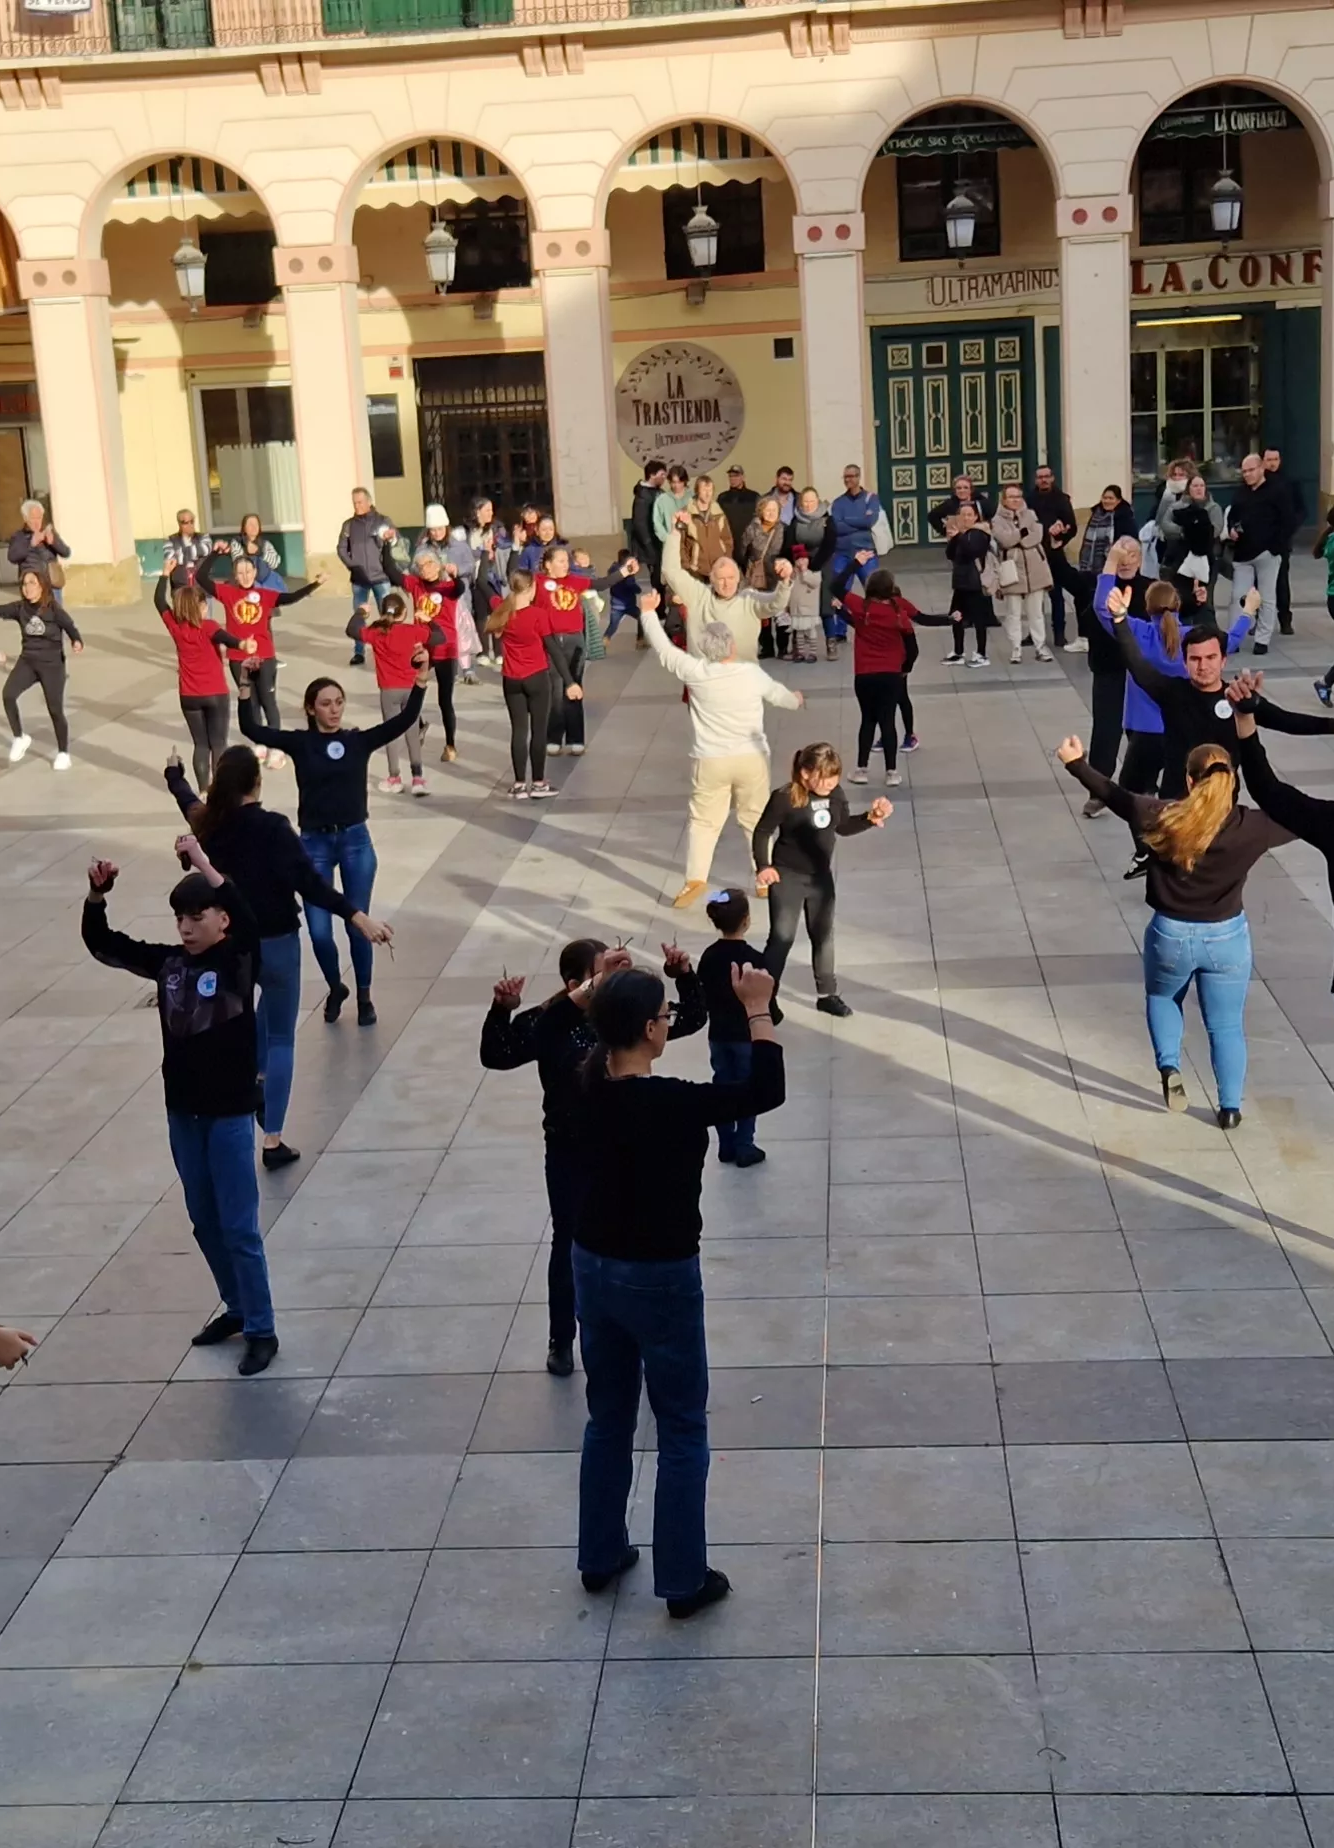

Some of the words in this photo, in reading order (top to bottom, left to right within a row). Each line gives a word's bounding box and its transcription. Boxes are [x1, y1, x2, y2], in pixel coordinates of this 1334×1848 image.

[1214, 110, 1228, 132] LA
[1230, 109, 1288, 131] CONFIANZA
[1131, 260, 1187, 295] LA
[666, 372, 685, 399] LA
[632, 398, 722, 428] TRASTIENDA
